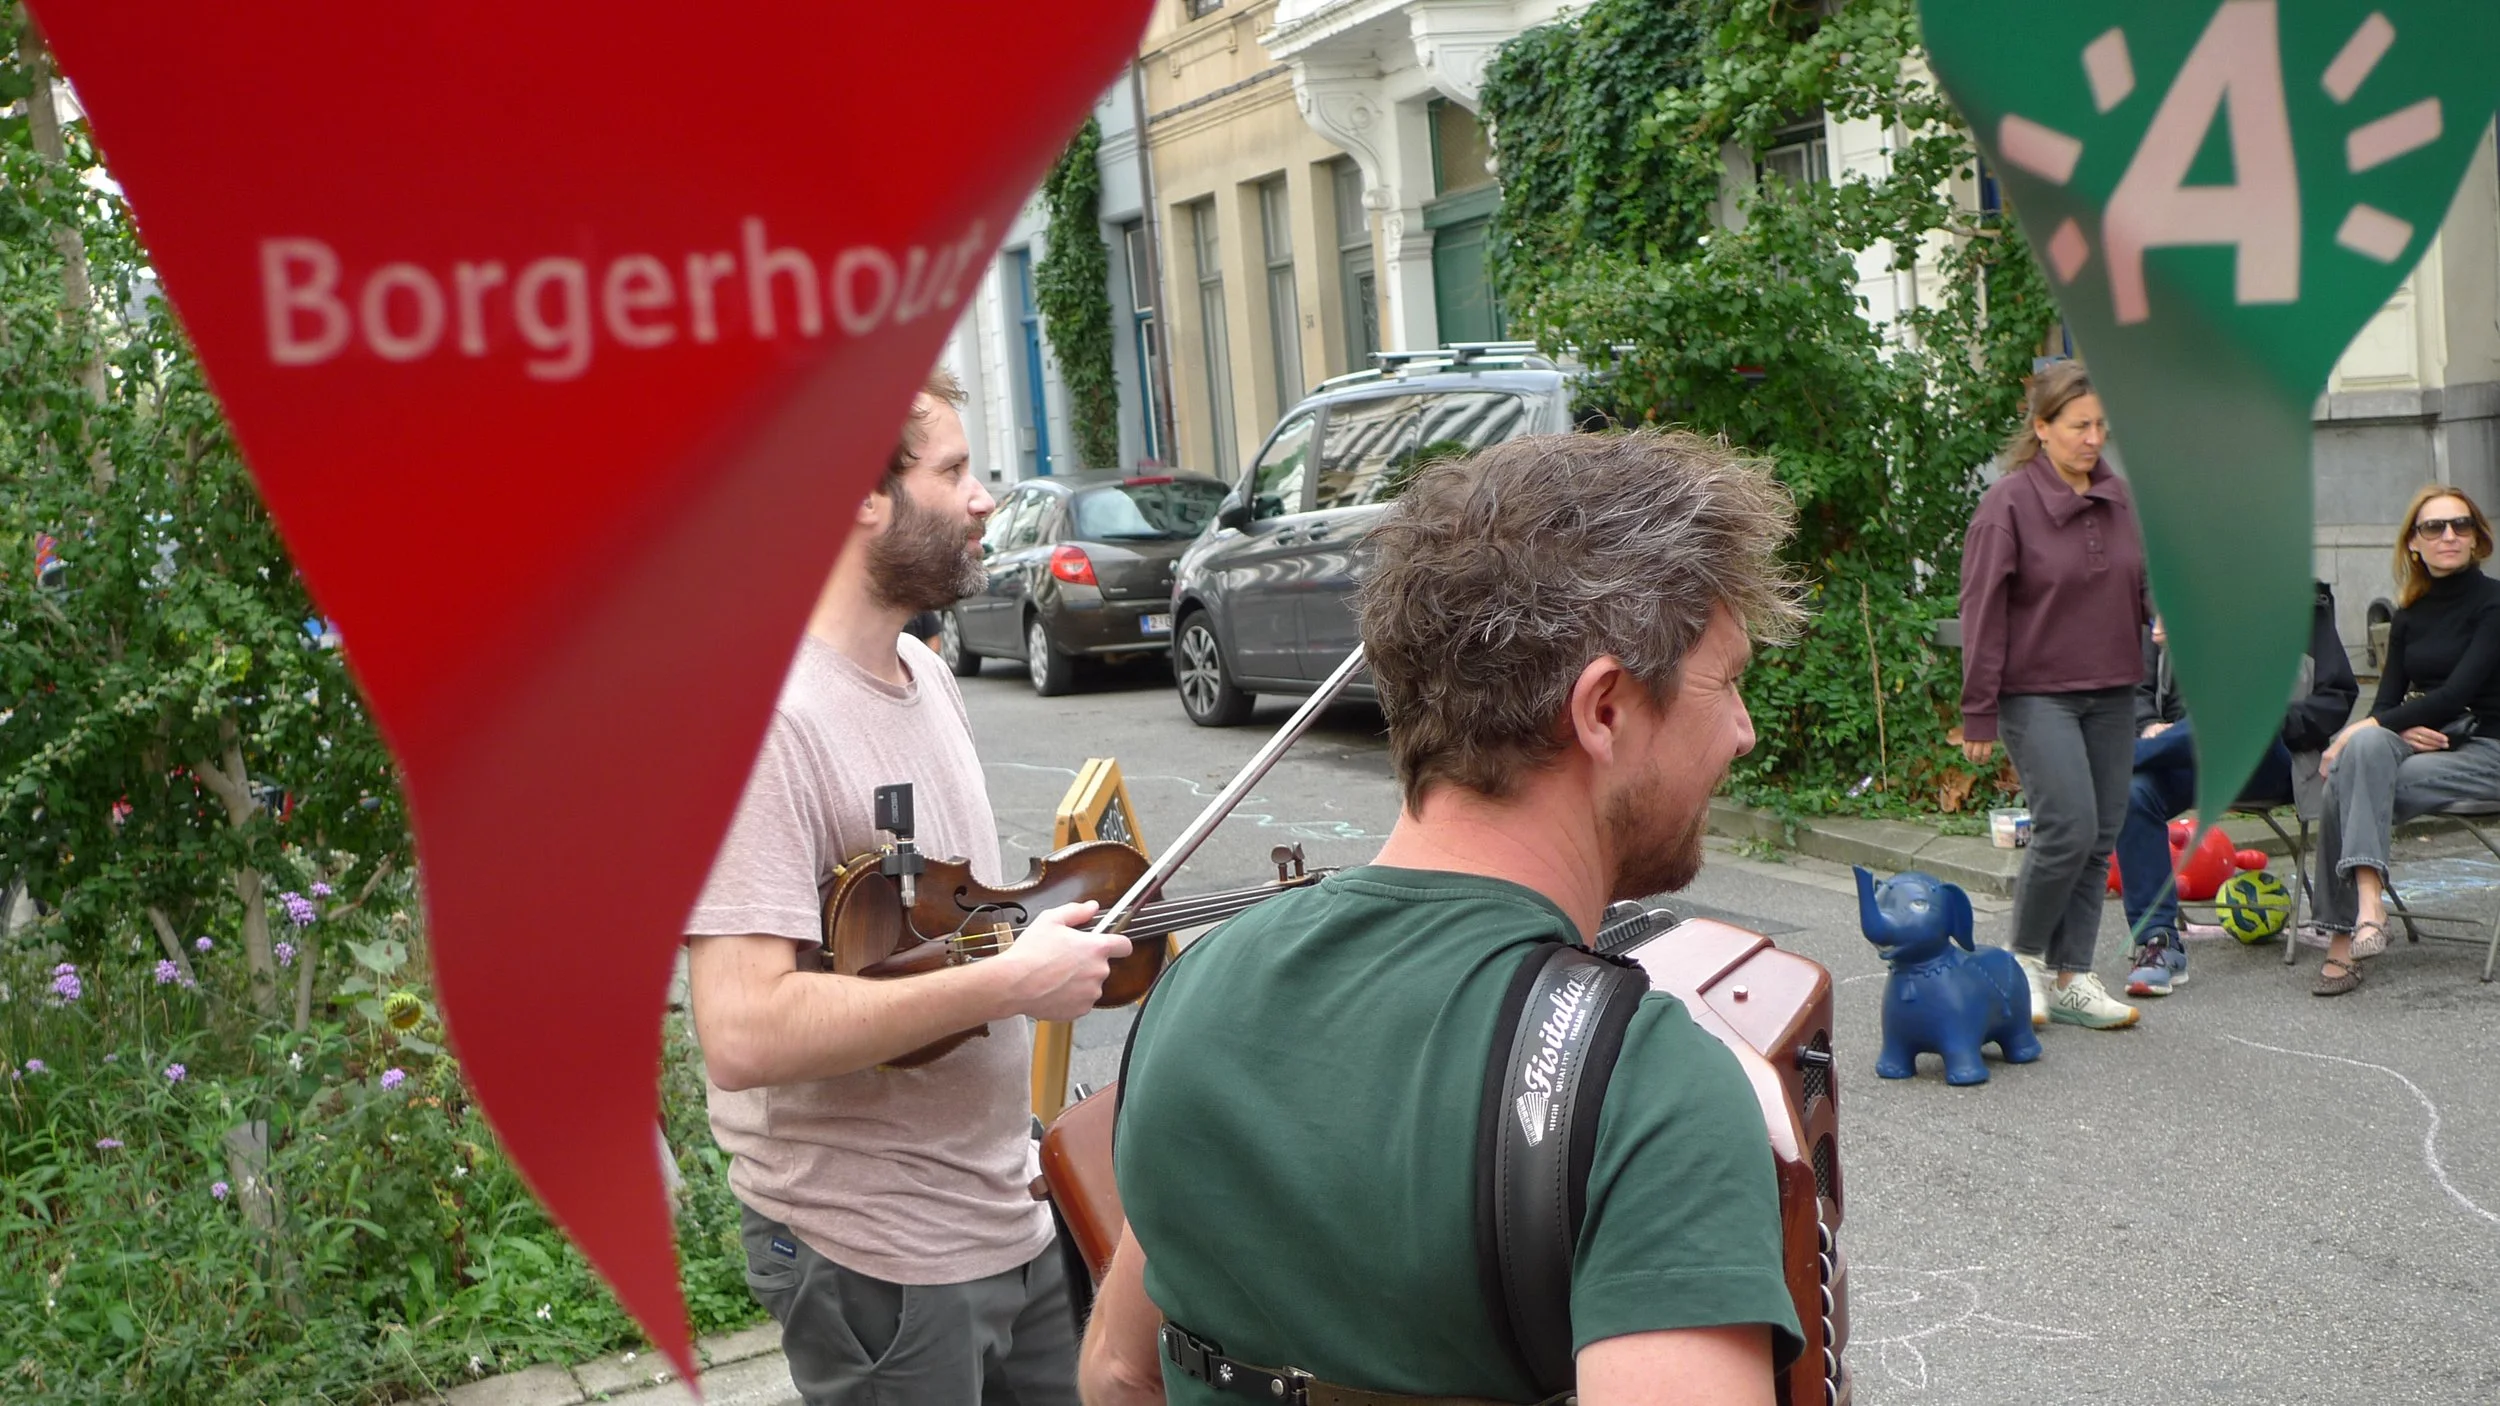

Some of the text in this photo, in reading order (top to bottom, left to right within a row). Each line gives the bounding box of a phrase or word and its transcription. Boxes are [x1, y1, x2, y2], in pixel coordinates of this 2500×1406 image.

[2104, 0, 2300, 325] A
[260, 216, 987, 380] Borgerhout
[1524, 979, 1586, 1099] Fisitalia
[1555, 1050, 1571, 1093] QUALITY
[1569, 1009, 1586, 1041] ITALIAN
